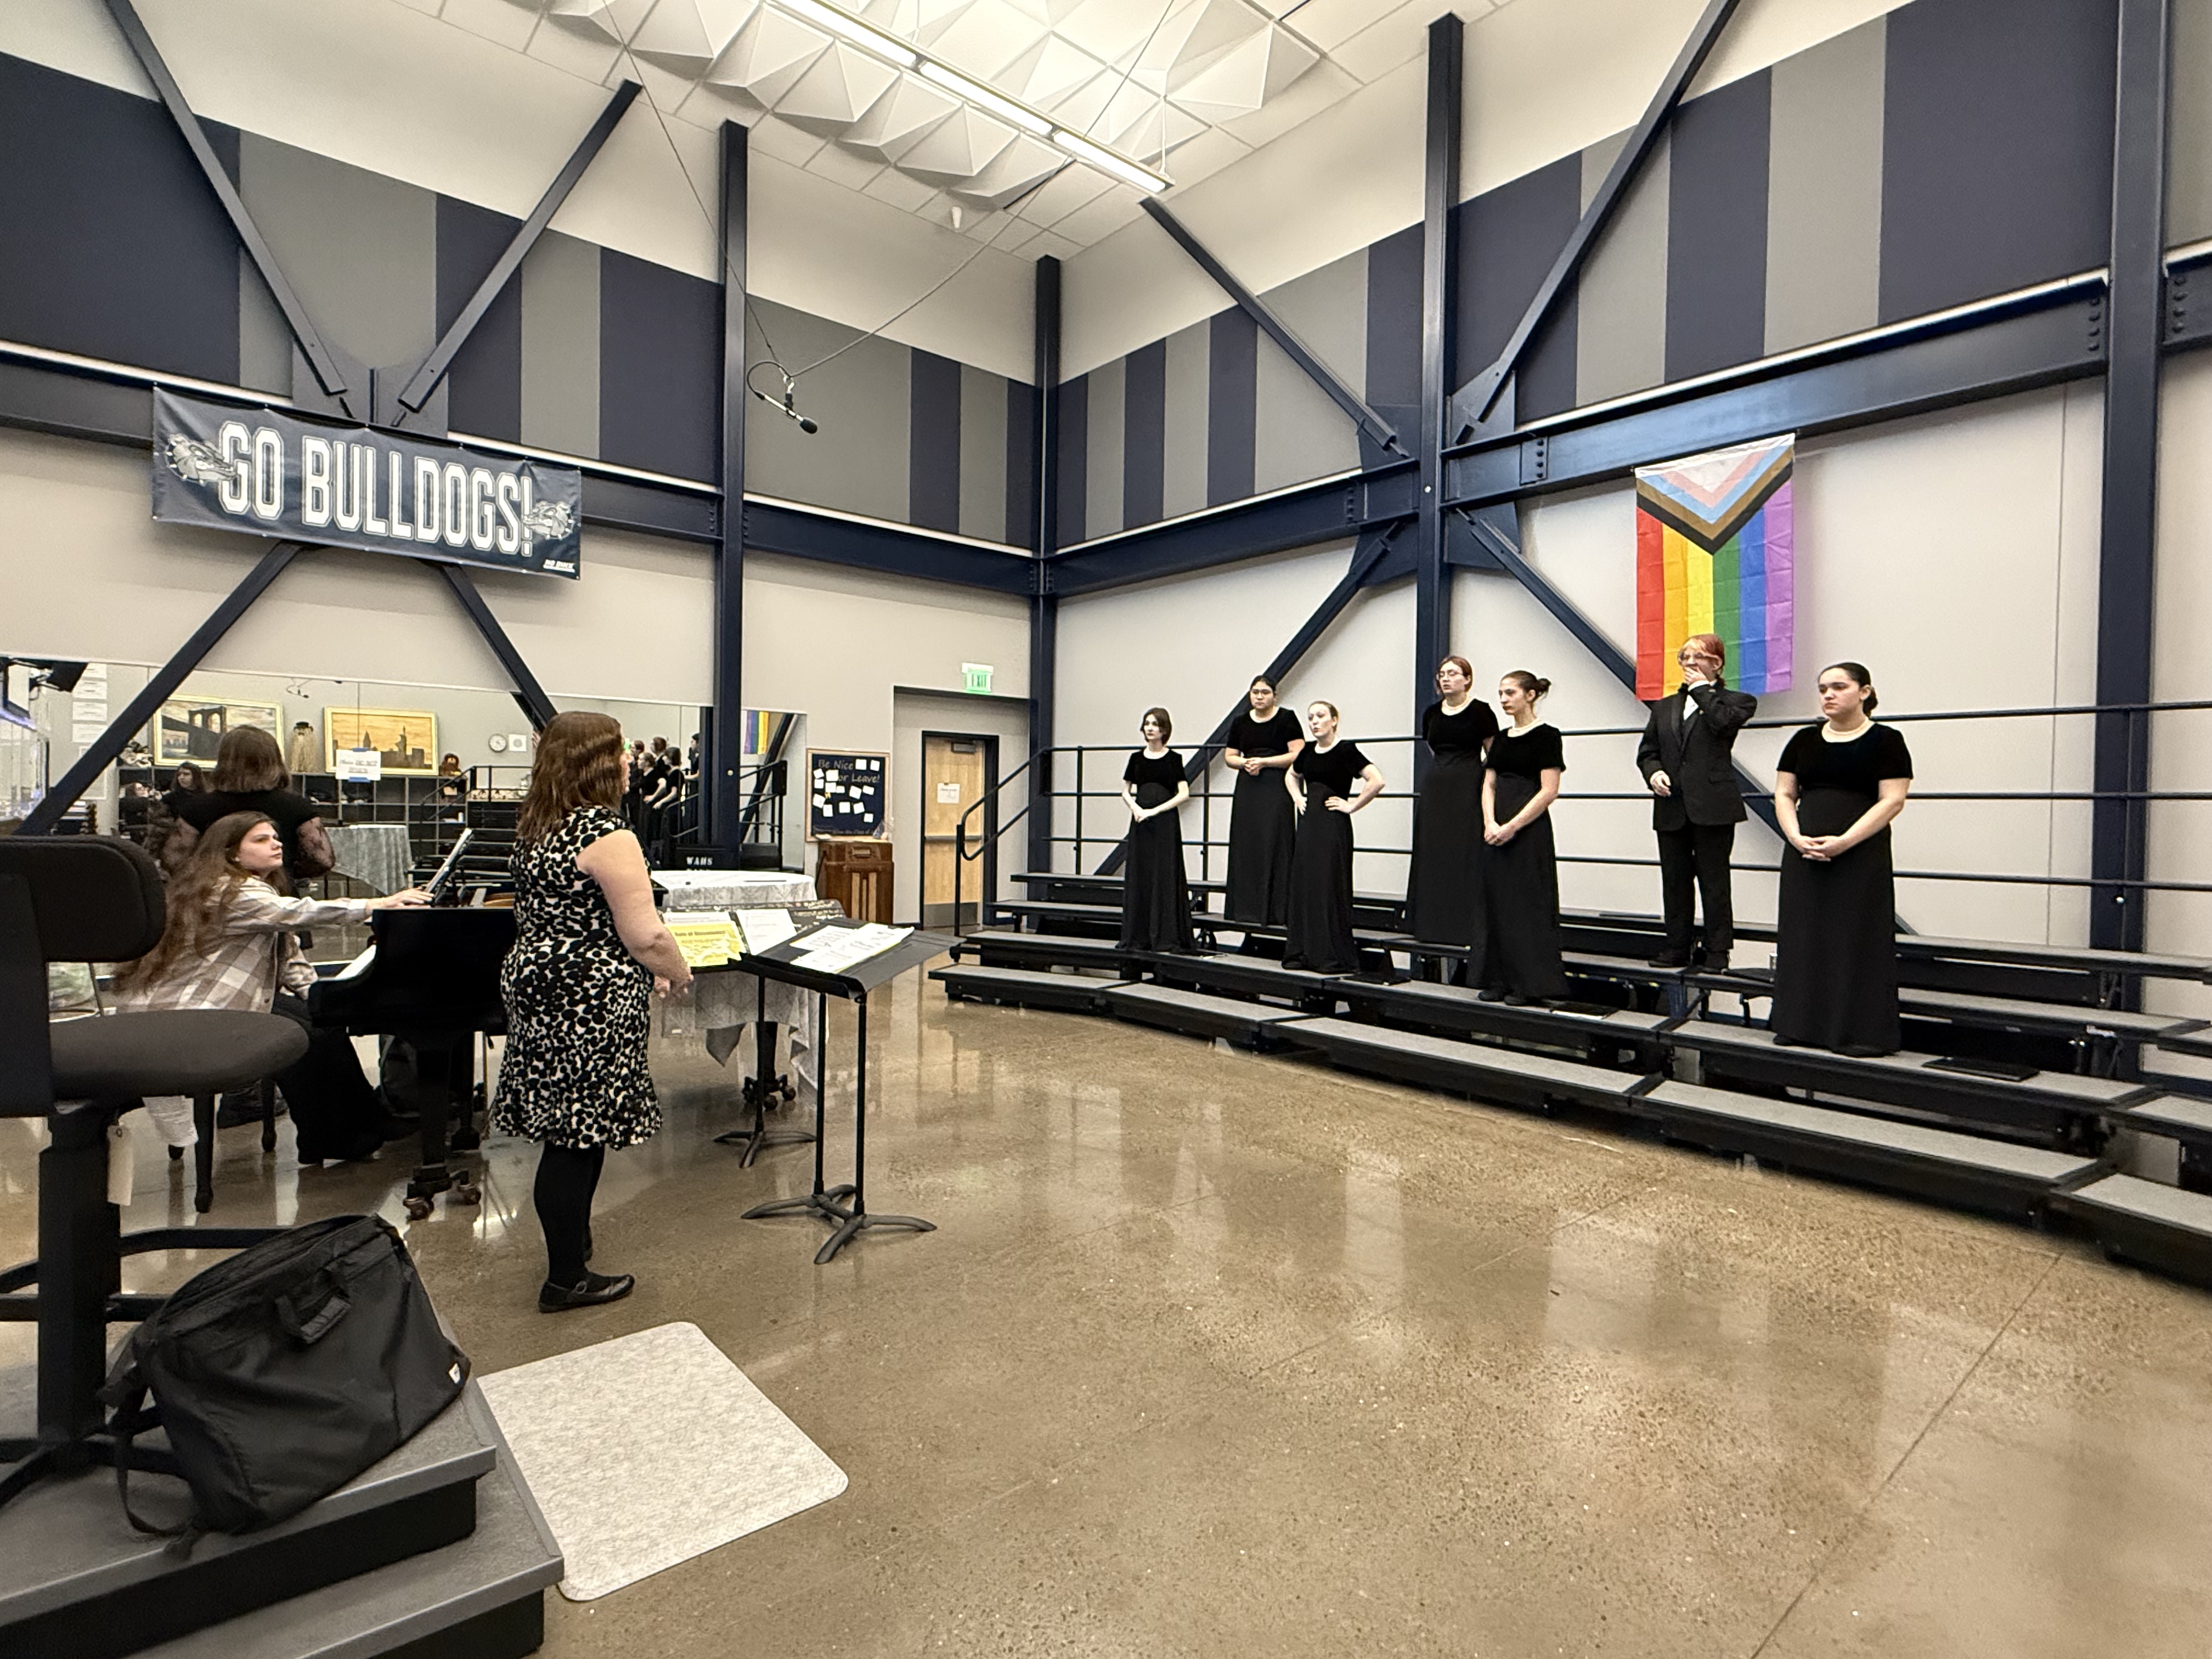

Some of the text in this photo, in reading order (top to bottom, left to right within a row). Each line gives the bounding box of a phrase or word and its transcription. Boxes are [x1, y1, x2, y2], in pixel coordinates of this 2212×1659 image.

[219, 420, 532, 557] GO BULLDOGS!
[818, 759, 854, 770] Be Nice
[851, 772, 880, 783] Leave!
